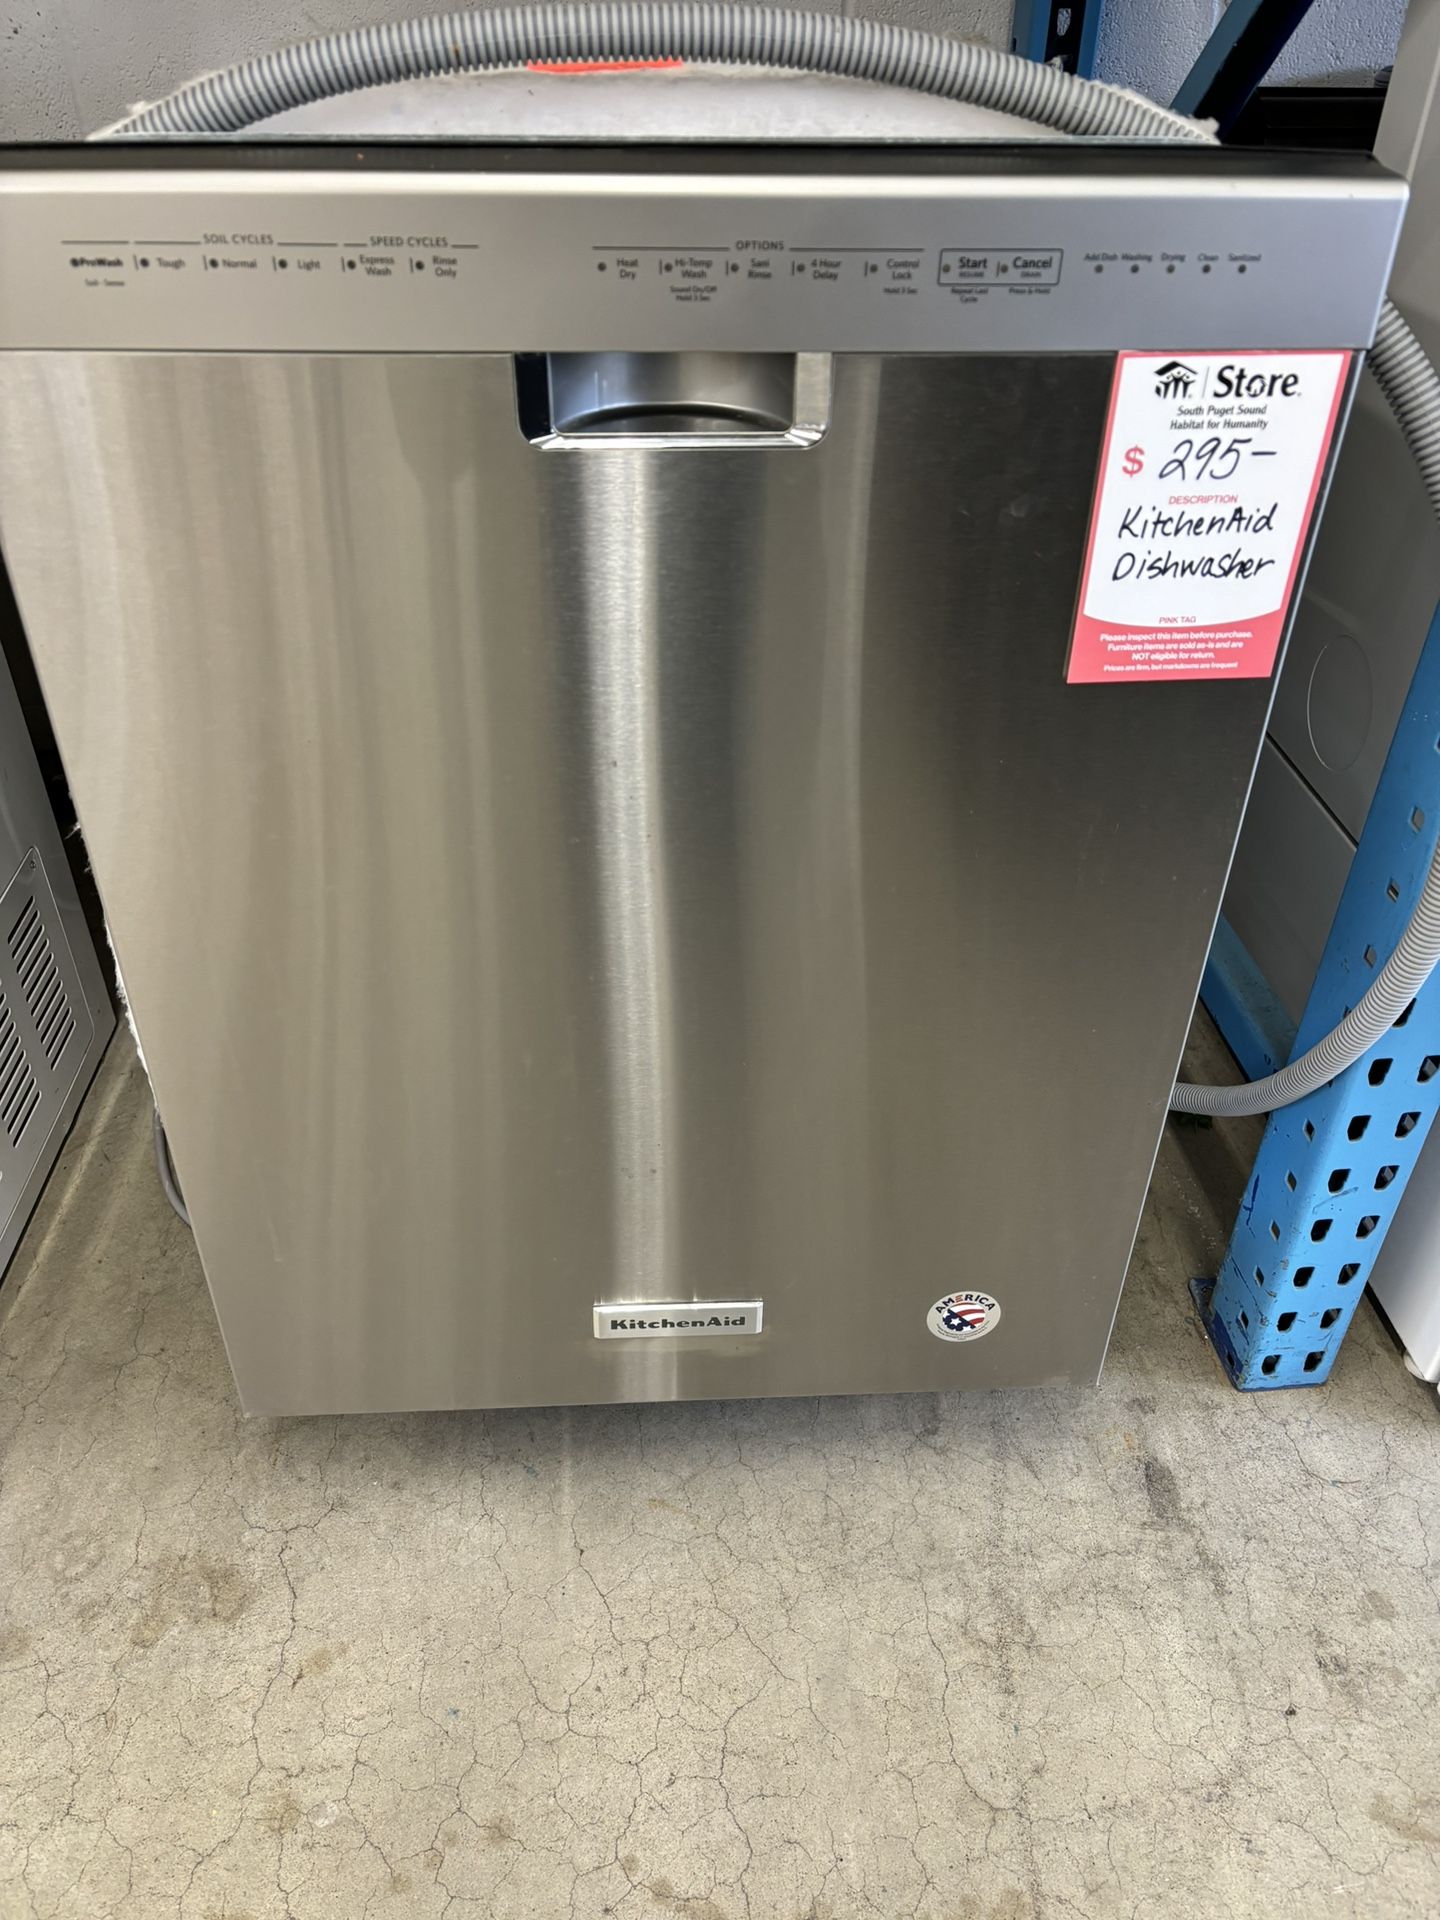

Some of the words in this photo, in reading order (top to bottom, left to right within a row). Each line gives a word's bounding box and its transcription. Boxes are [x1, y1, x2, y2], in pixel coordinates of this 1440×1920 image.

[203, 234, 228, 244] SOIL
[232, 234, 274, 245] CYCLES
[369, 236, 403, 247] SPEED
[407, 237, 448, 248] CYCLES
[735, 240, 785, 250] OPTIONS
[360, 255, 395, 266] Express
[433, 255, 457, 266] Rinse
[617, 258, 638, 267] Heat
[959, 256, 987, 269] Start
[1013, 256, 1053, 269] Cancel
[1121, 253, 1152, 263] Washing
[1161, 253, 1185, 263] Drying
[1198, 253, 1219, 261] Clean
[1228, 253, 1262, 261] Sanitized
[156, 257, 185, 269] Tough
[222, 258, 257, 268] Normal
[297, 259, 320, 271] Light
[675, 257, 713, 269] Hi-Temp
[751, 258, 770, 268] Sani
[811, 259, 818, 268] 4
[819, 259, 842, 268] Hour
[886, 258, 920, 269] Control
[366, 267, 392, 276] Wash
[435, 267, 457, 278] Only
[620, 269, 636, 280] Dry
[682, 270, 707, 279] Wash
[748, 270, 772, 279] Rinse
[813, 270, 838, 281] Delay
[892, 271, 912, 280] Lock
[1213, 365, 1299, 398] Store
[1177, 406, 1204, 416] South
[1207, 405, 1234, 417] Puget
[1237, 404, 1267, 415] Sound
[1170, 420, 1204, 430] Habitat
[1207, 420, 1220, 429] for
[1223, 419, 1268, 430] Humanity
[1122, 445, 1145, 477] $
[1168, 495, 1238, 505] DESCRIPTION
[1118, 503, 1278, 538] KitchenAid
[1112, 548, 1275, 581] Dishwasher
[1159, 616, 1178, 624] PINK
[1100, 633, 1126, 642] Please
[1127, 632, 1156, 641] inspect
[1157, 632, 1171, 640] this
[1190, 631, 1215, 640] before
[1216, 630, 1253, 640] purchase.
[1215, 641, 1231, 649] and
[1150, 653, 1178, 661] eligible
[936, 1294, 996, 1314] AMERICA
[610, 1317, 745, 1330] KitchenAid
